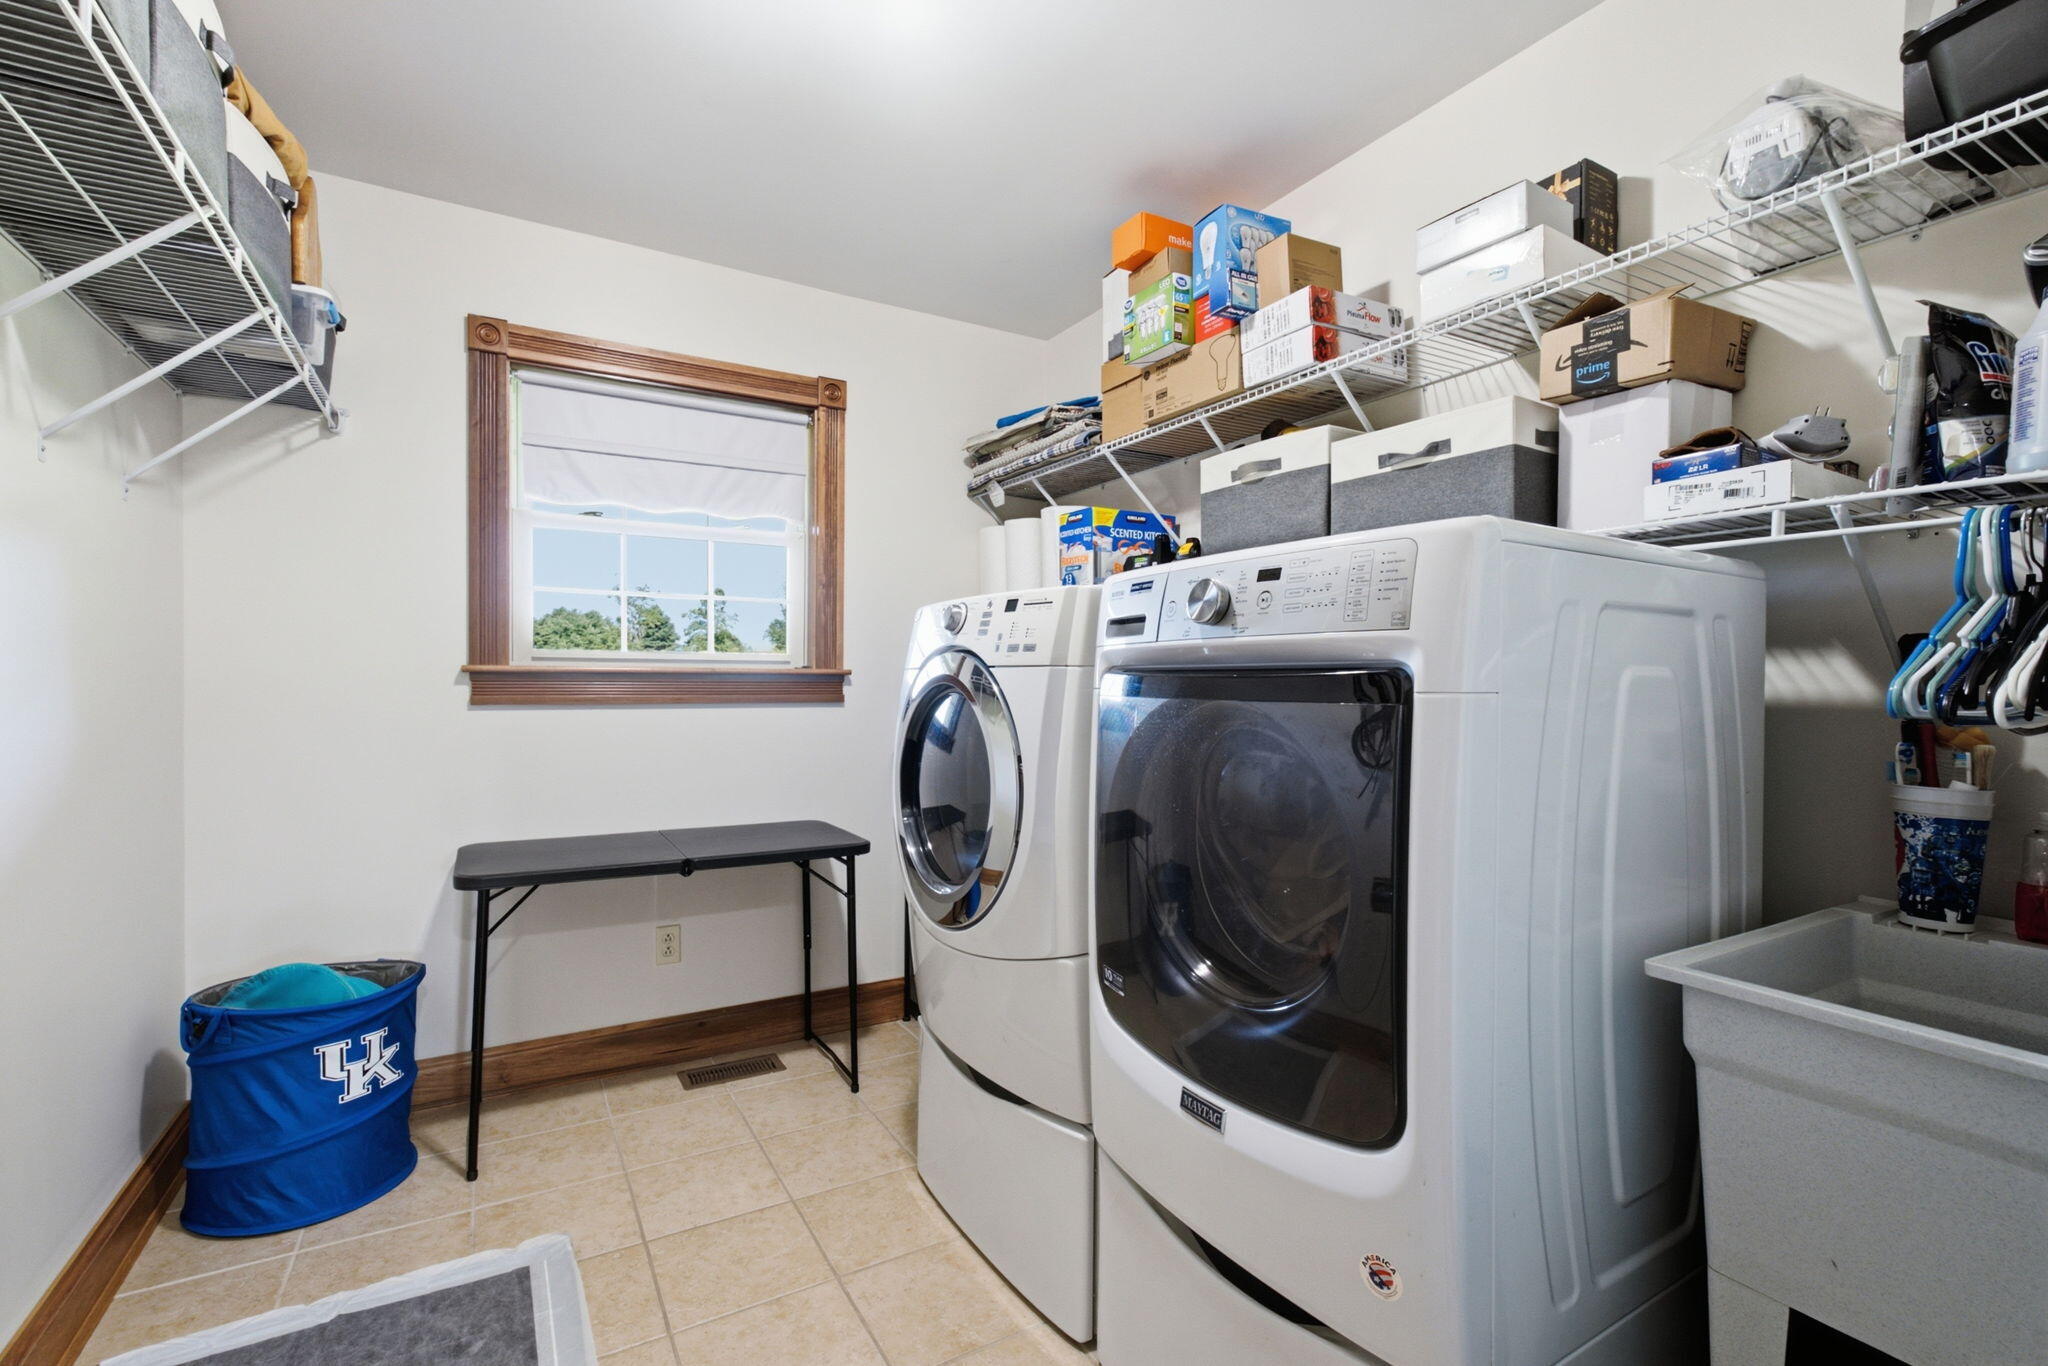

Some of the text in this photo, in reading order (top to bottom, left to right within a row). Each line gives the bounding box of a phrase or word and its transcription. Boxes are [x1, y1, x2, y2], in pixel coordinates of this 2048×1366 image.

[1576, 361, 1610, 379] prime
[1109, 527, 1143, 540] SCENTED
[314, 1026, 404, 1104] UK
[1182, 1090, 1222, 1126] MAYTAG
[1362, 1254, 1397, 1276] AMERICA
